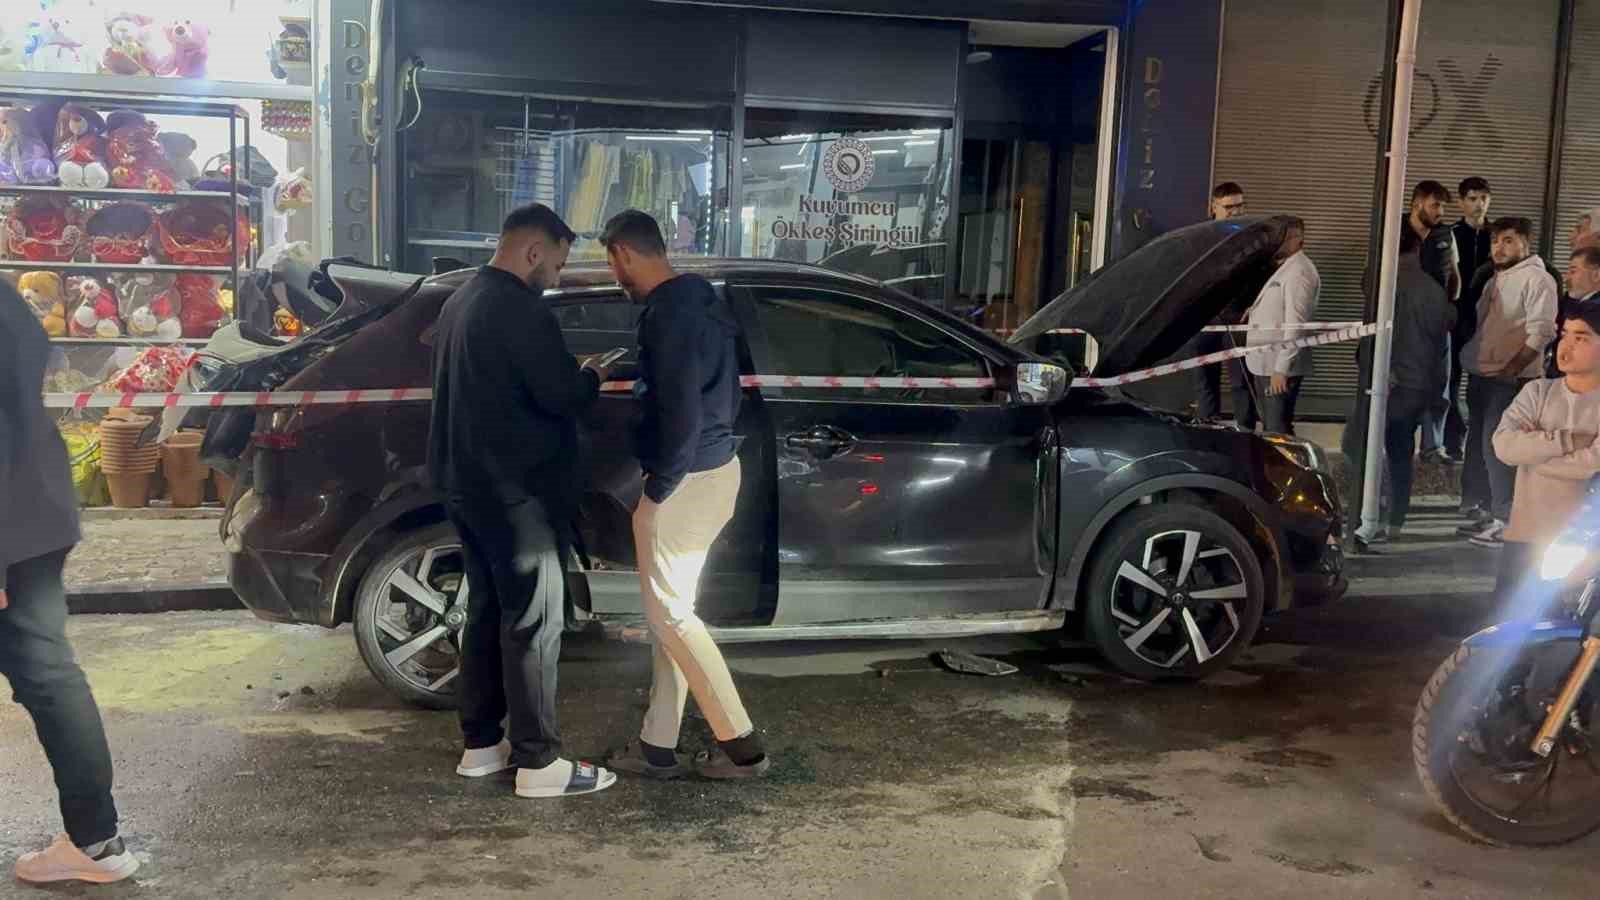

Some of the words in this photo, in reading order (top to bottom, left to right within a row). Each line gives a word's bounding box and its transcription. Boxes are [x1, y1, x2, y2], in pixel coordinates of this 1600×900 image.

[799, 195, 897, 218] Kuyumcu
[771, 216, 837, 243] Ökkeş
[839, 223, 921, 247] Şiringül
